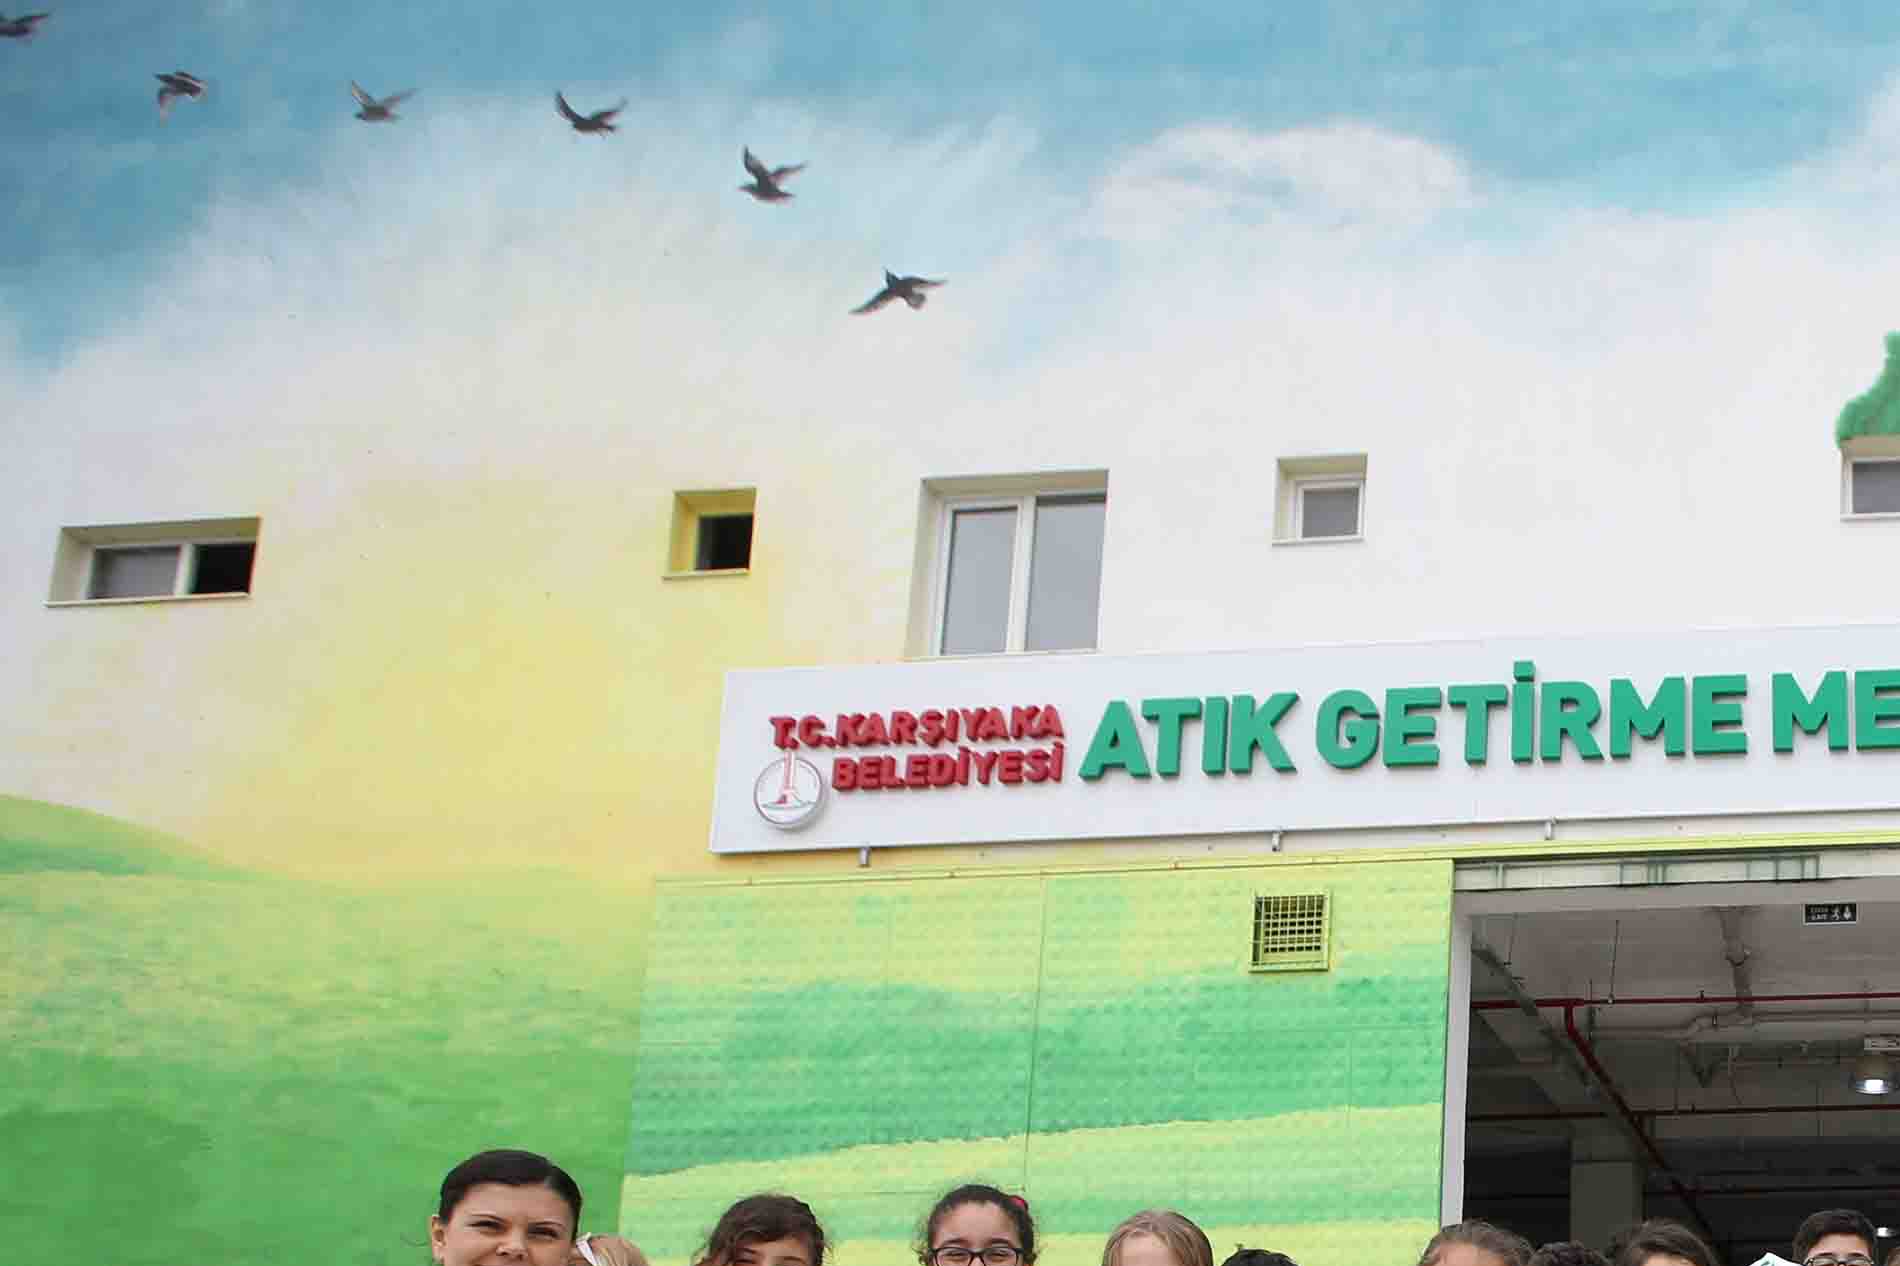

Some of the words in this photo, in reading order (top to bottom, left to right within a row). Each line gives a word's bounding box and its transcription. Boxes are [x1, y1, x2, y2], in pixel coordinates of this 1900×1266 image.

[1078, 692, 1300, 780] ATIK
[1315, 660, 1749, 769] GETİRME
[831, 741, 1065, 791] BELEDİYESİ
